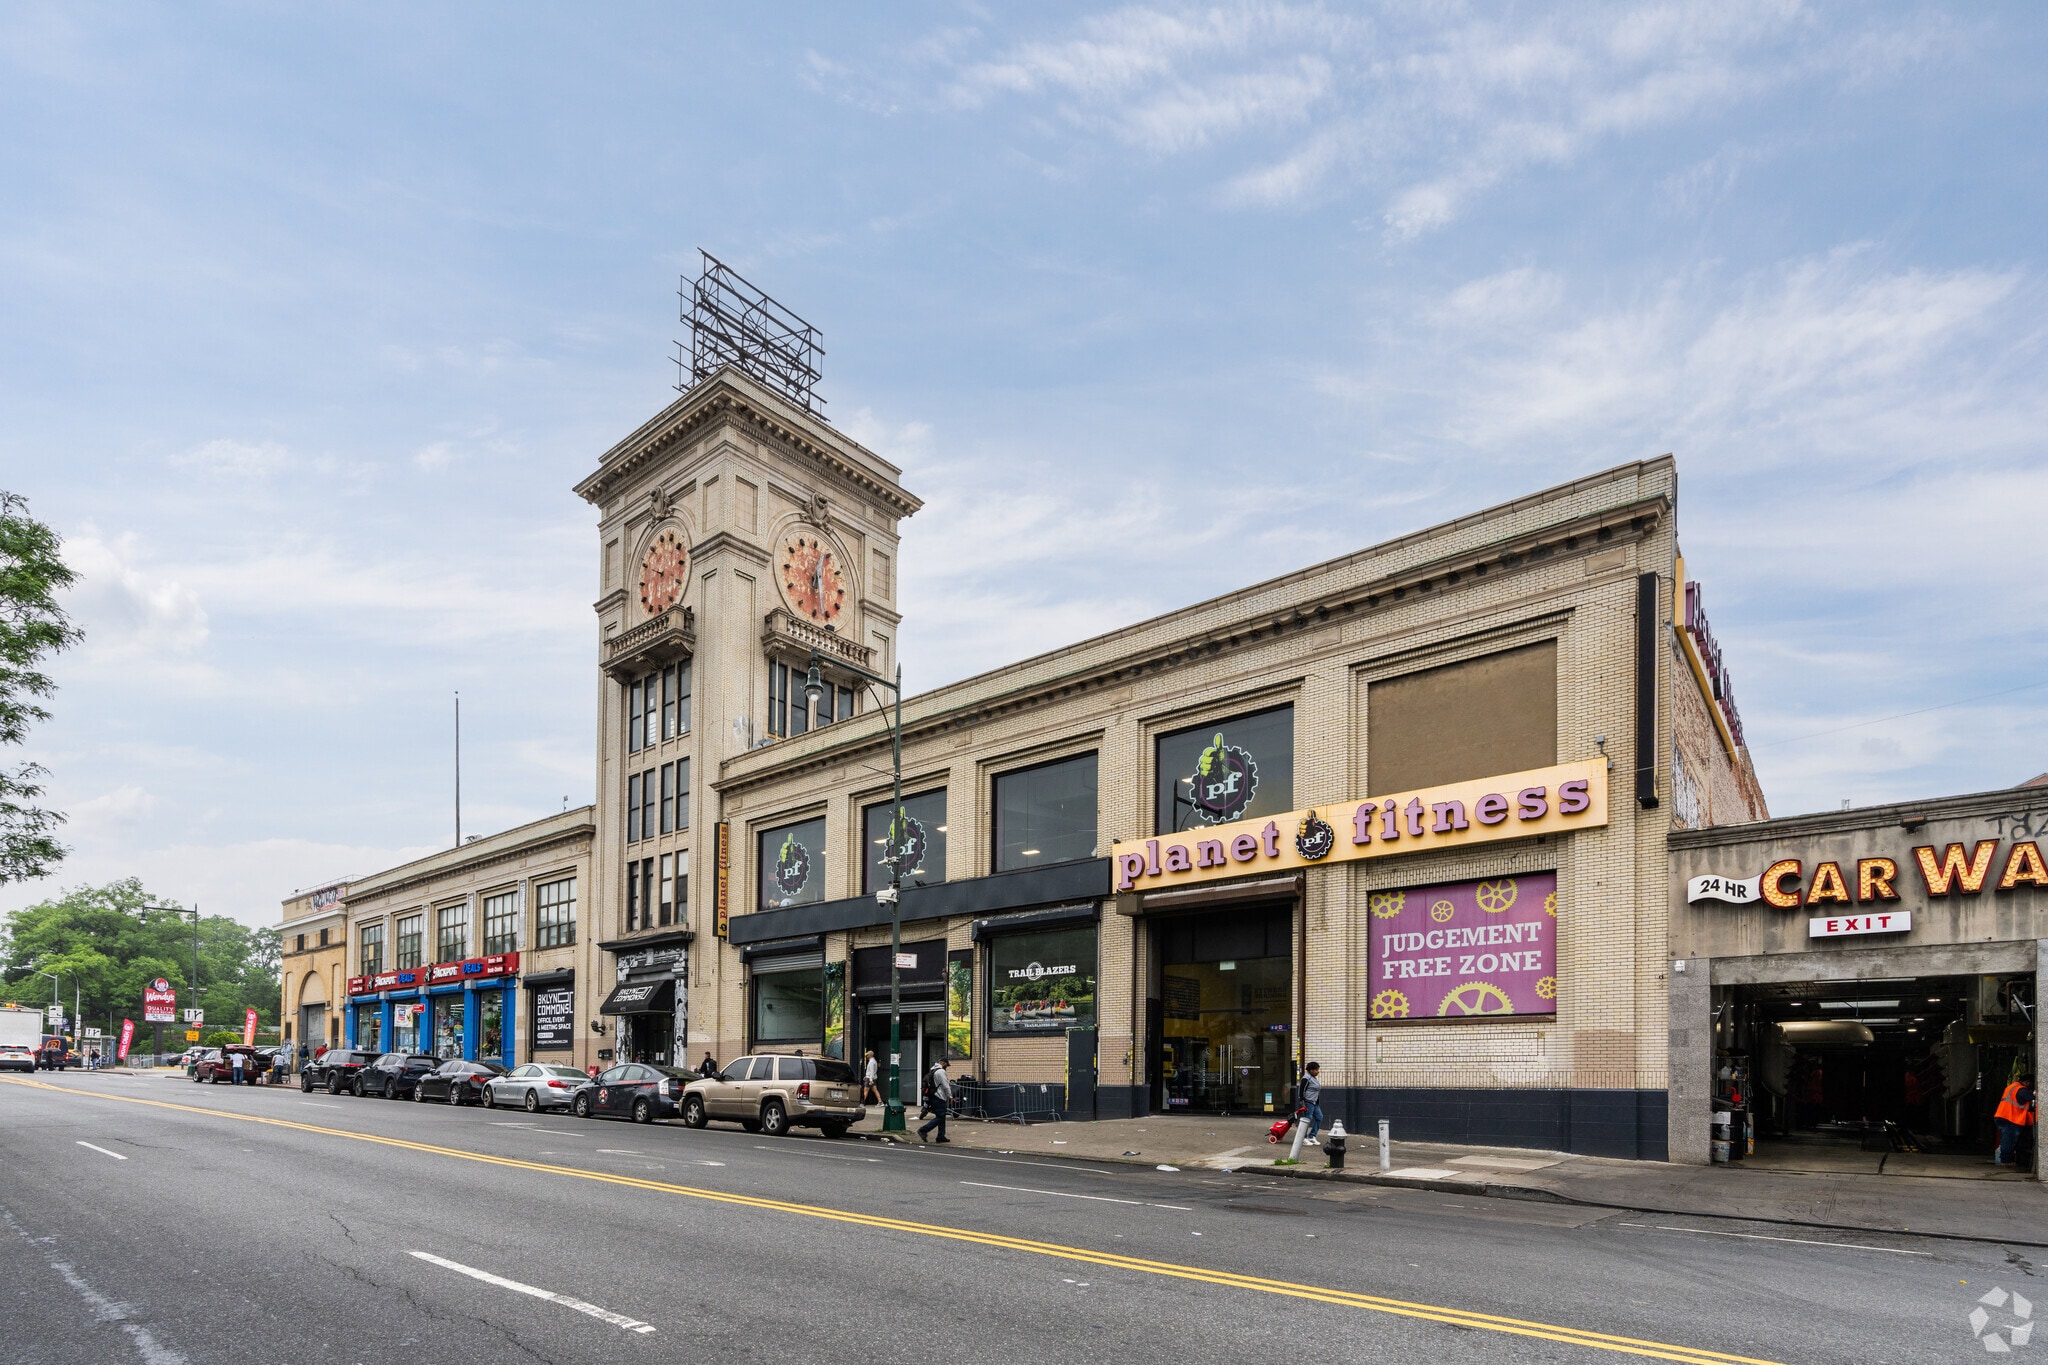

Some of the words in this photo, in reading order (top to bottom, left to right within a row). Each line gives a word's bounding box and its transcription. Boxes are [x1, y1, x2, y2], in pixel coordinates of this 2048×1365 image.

[1206, 772, 1242, 800] pf
[1118, 820, 1280, 890] planet
[1352, 779, 1592, 845] fitness
[1303, 831, 1326, 848] pf
[719, 827, 727, 871] fitness
[783, 860, 803, 880] pf
[1759, 859, 1901, 910] CAR
[1912, 839, 2048, 897] WA
[1700, 878, 1721, 894] 24
[1725, 880, 1748, 899] HR
[718, 876, 728, 920] planet
[1826, 915, 1892, 933] EXIT
[1382, 921, 1542, 958] JUDGEMENT
[462, 962, 483, 974] DEALS
[1008, 968, 1034, 979] TRAIL
[1035, 964, 1077, 977] BLAZERS
[1382, 956, 1452, 980] FREE
[1459, 950, 1542, 975] ZONE
[398, 972, 416, 984] DEALS
[146, 991, 175, 1003] Wendy's
[537, 993, 558, 1005] BKLYN
[612, 994, 643, 1002] COMMONS
[537, 1004, 569, 1016] COMMONS
[541, 1023, 558, 1031] MEETING
